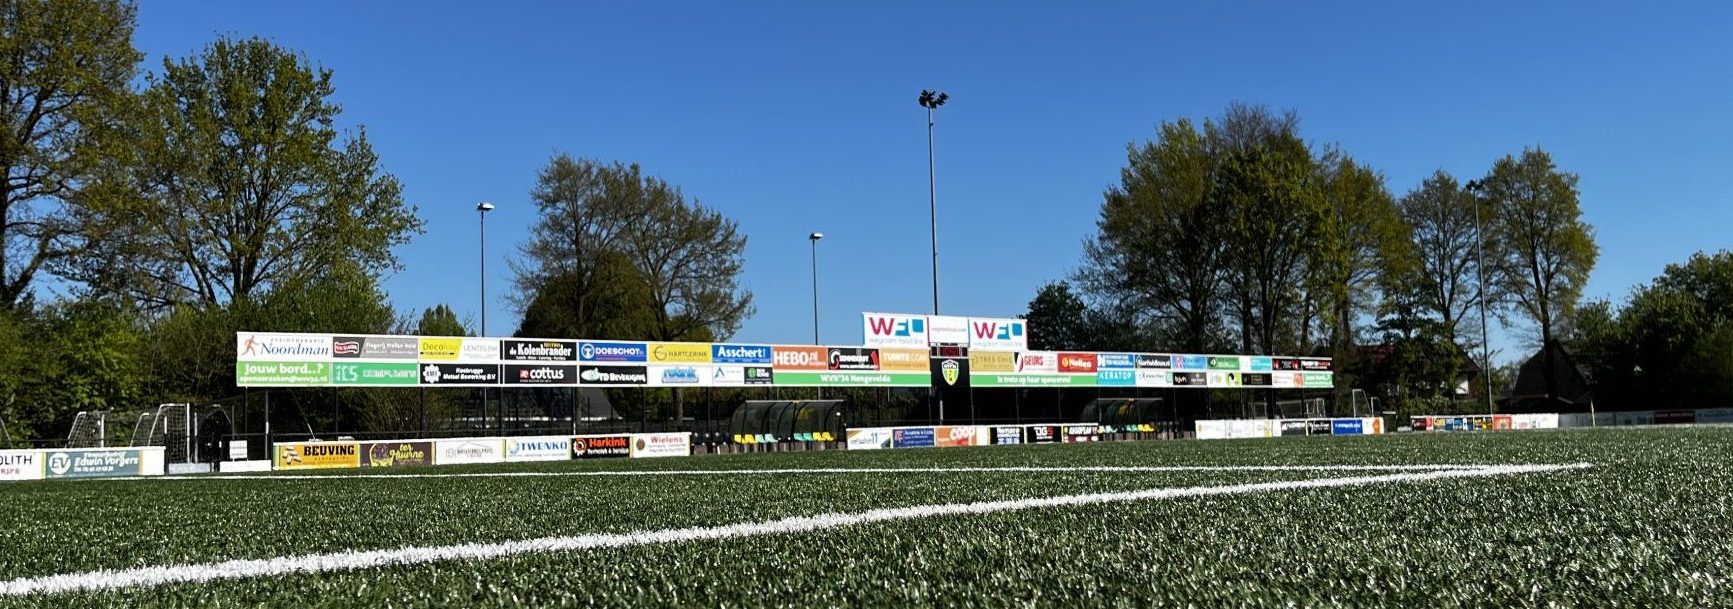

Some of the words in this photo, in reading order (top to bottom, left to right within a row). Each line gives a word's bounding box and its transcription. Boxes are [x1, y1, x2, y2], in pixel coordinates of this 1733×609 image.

[260, 342, 329, 355] Noordman
[517, 343, 572, 356] Kolenbrander
[244, 363, 277, 375] Jouw
[529, 367, 564, 379] cottus
[589, 437, 626, 447] Harkink
[303, 444, 355, 456] BEUVING
[74, 456, 103, 466] Edwin
